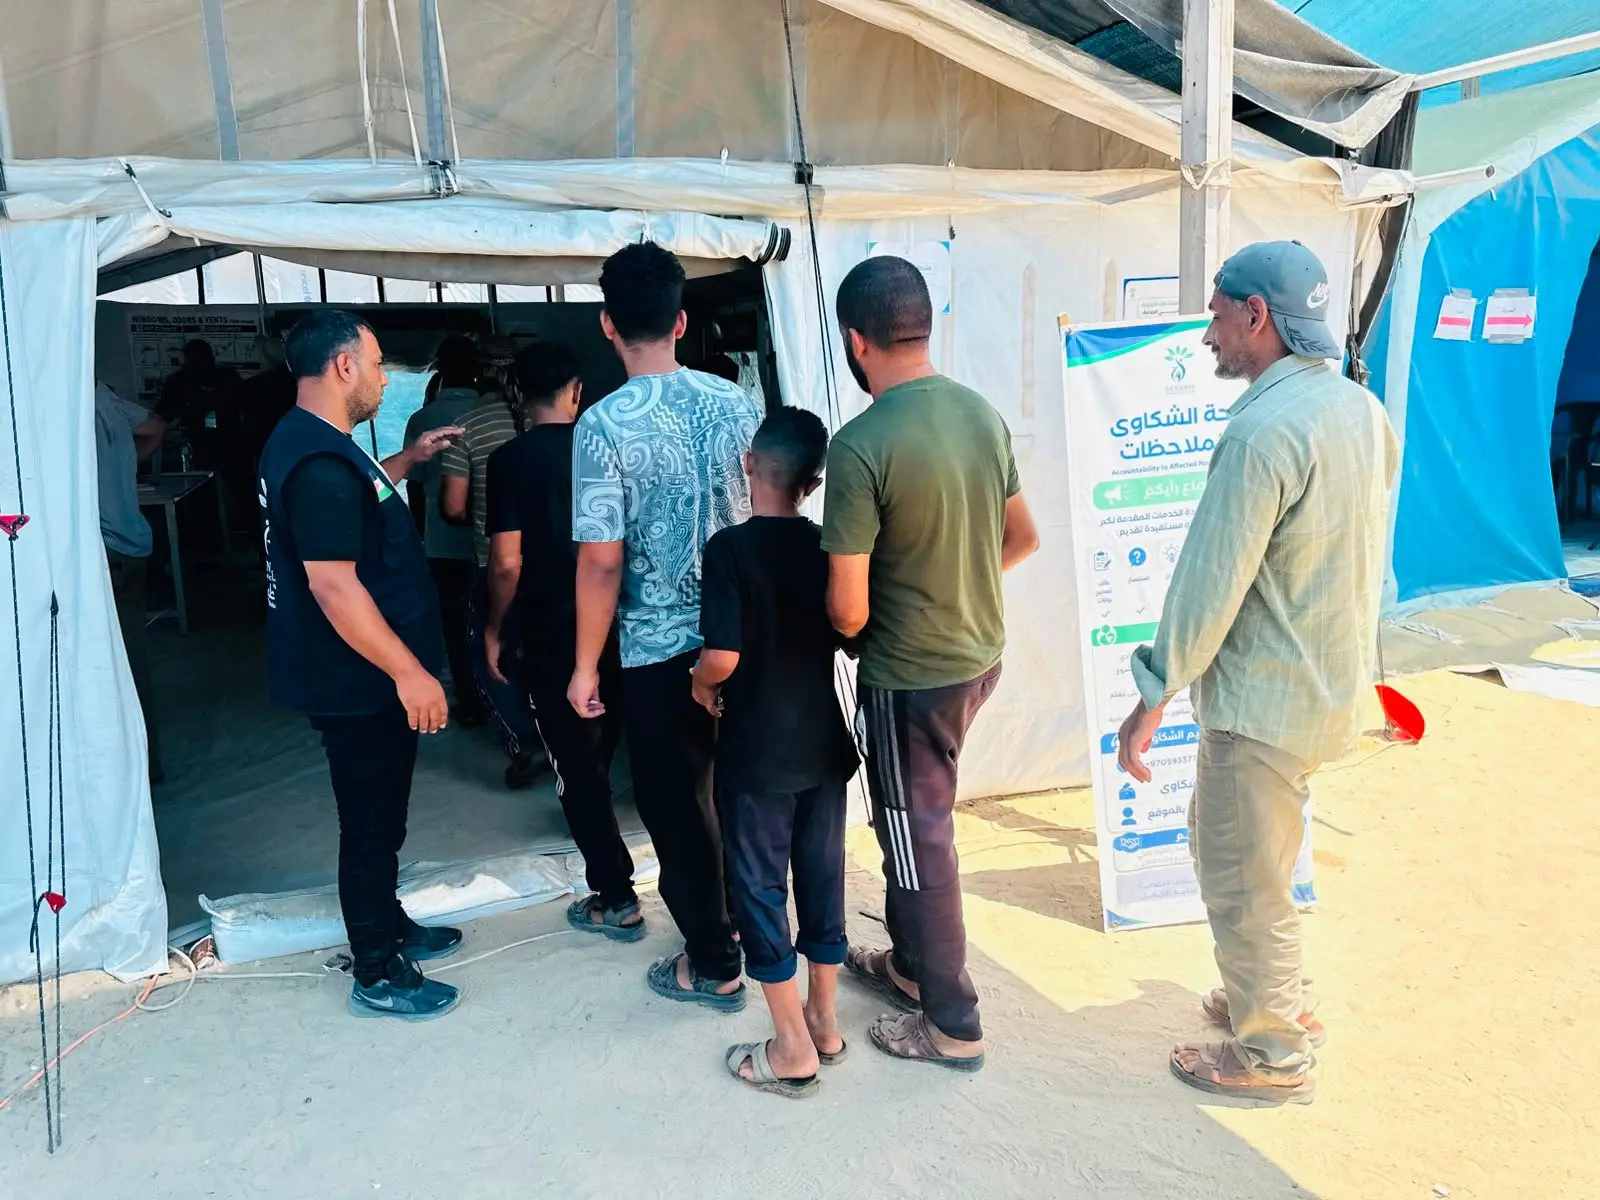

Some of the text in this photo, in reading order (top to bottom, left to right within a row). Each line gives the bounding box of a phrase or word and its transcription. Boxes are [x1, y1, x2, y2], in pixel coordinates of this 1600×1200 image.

[1110, 404, 1231, 437] حة الشكاوى
[1120, 434, 1218, 459] ملاحظات
[1112, 466, 1160, 475] Accountability
[1169, 461, 1197, 470] Affected
[1152, 728, 1184, 745] الشكاو
[1148, 805, 1186, 821] بالموقع
